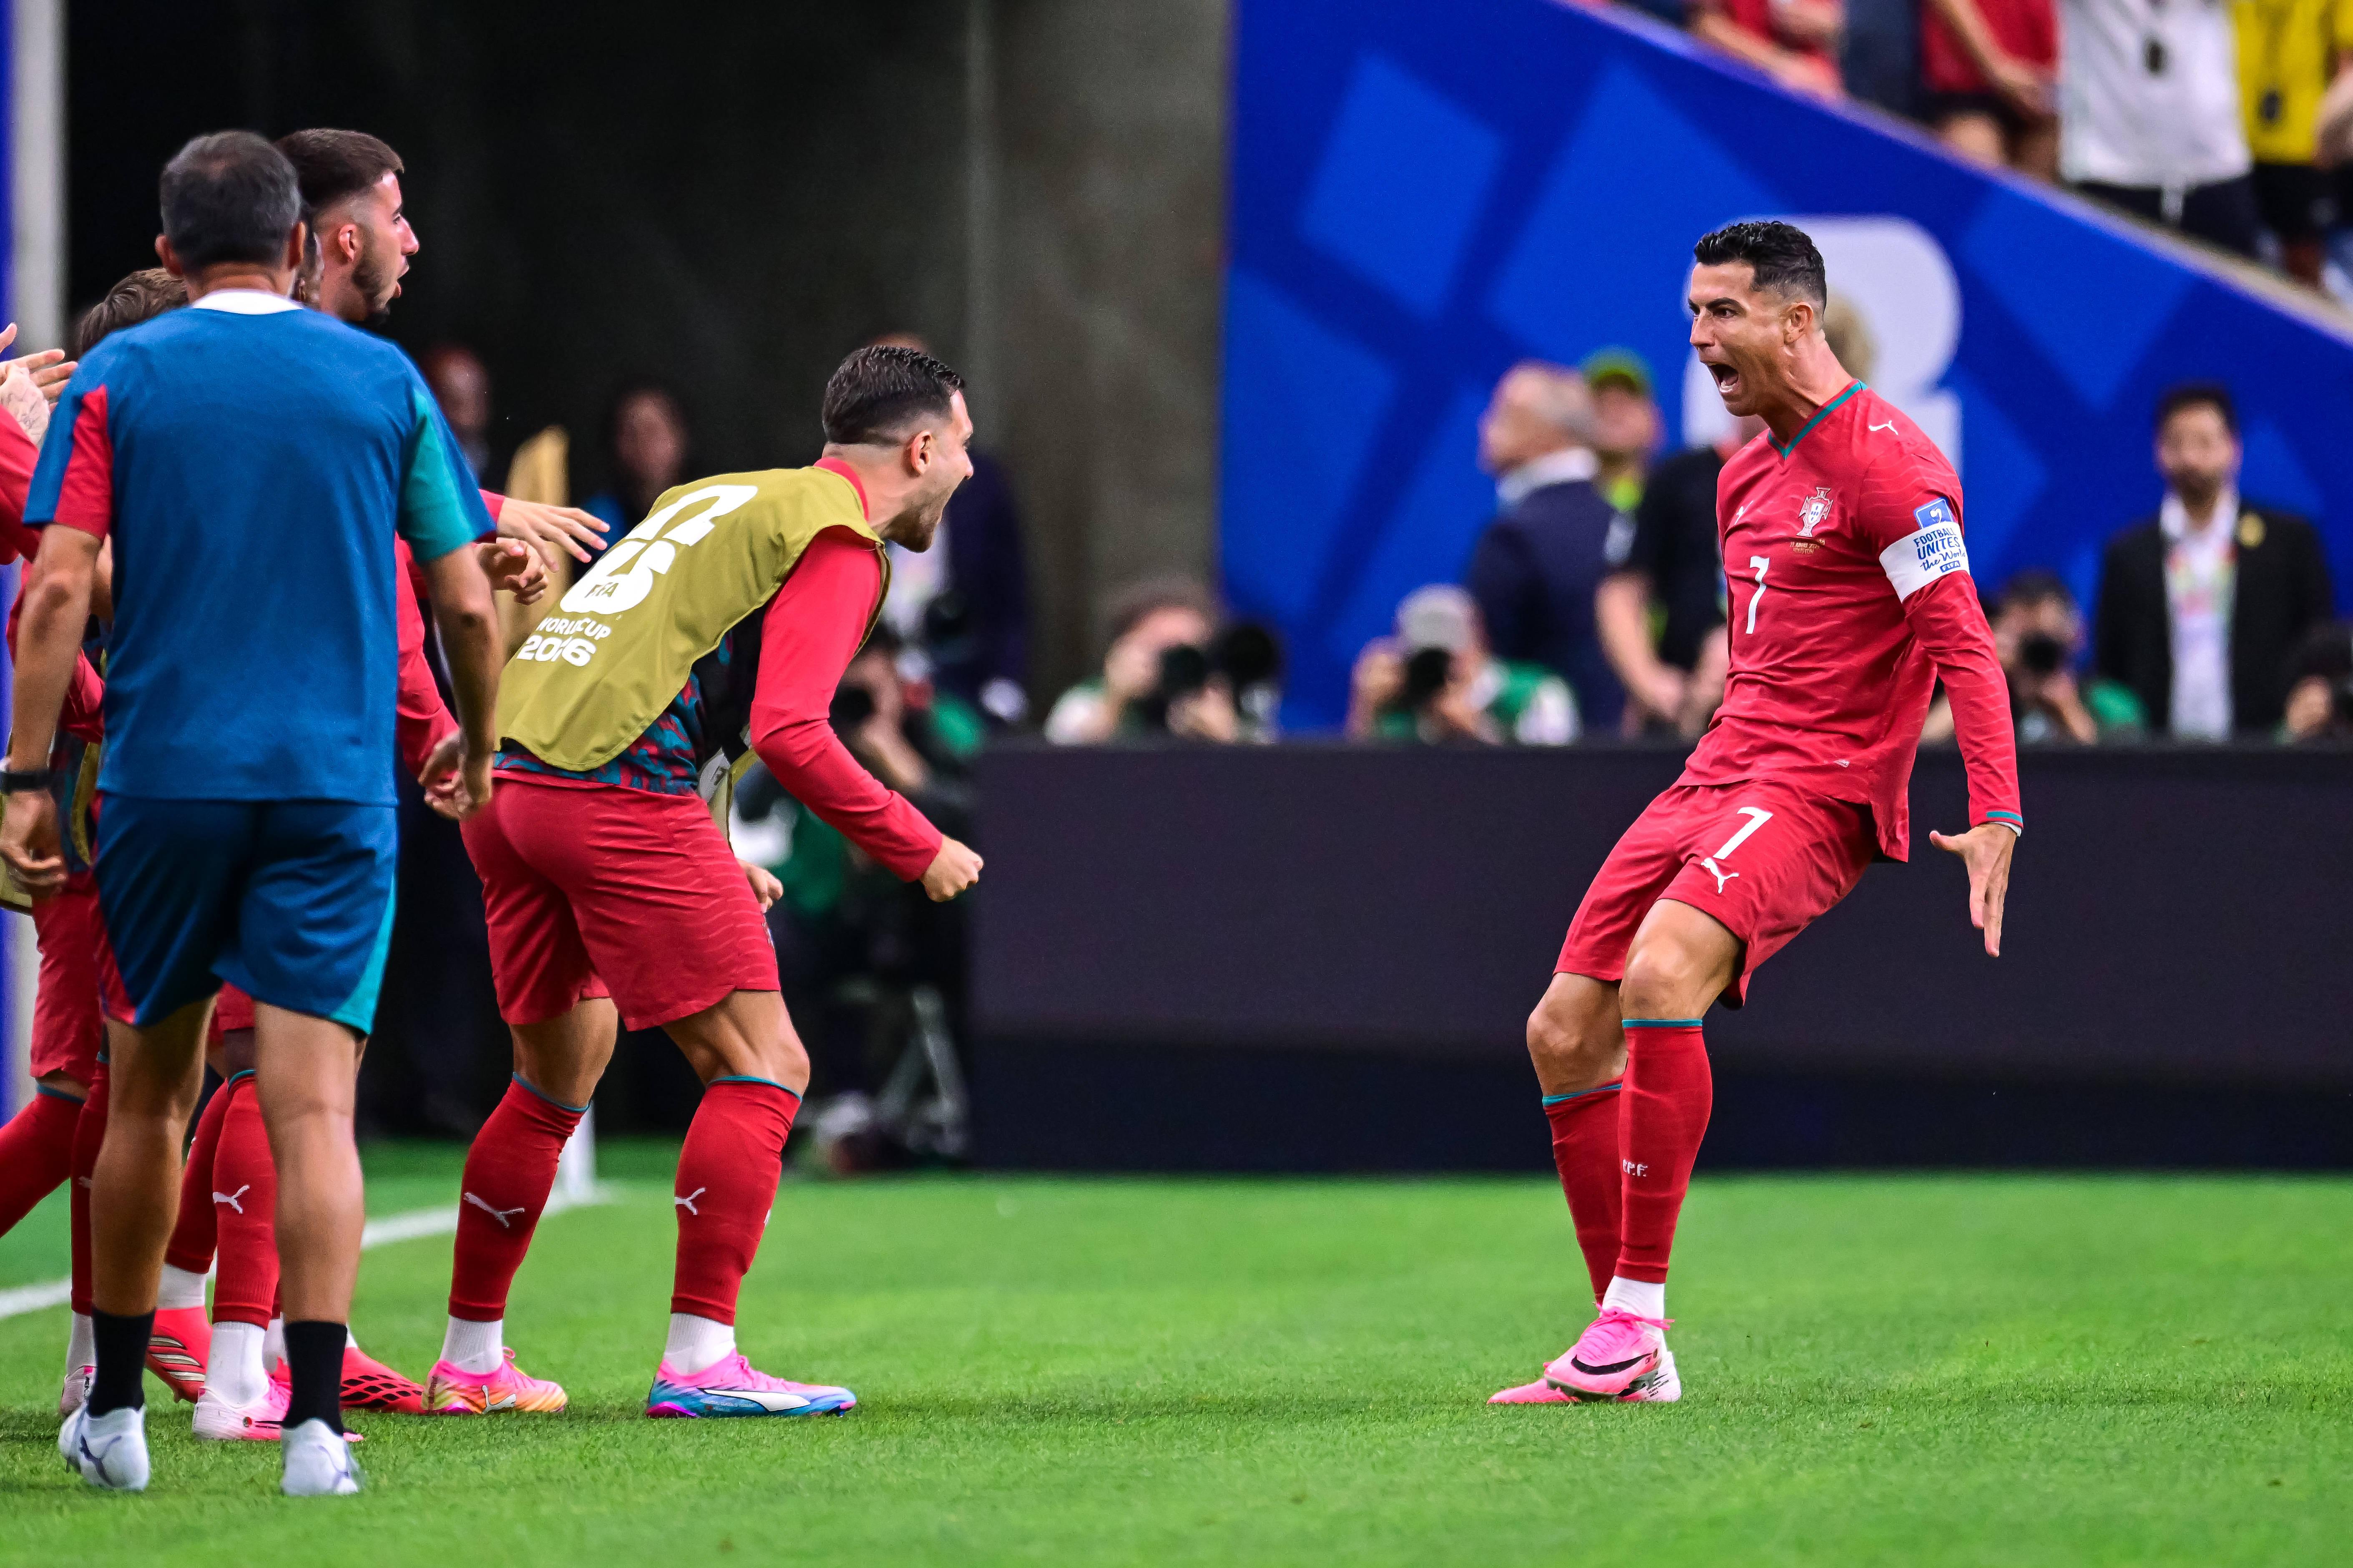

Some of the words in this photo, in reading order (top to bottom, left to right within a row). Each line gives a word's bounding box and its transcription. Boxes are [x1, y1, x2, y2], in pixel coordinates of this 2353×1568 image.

[1913, 528, 1956, 548] FOOTBALL
[1917, 537, 1960, 560] UNITES
[1920, 559, 1940, 571] the
[1939, 548, 1966, 562] World
[1746, 556, 1770, 634] 7
[576, 617, 611, 641] CUP
[1713, 807, 1774, 860] 7
